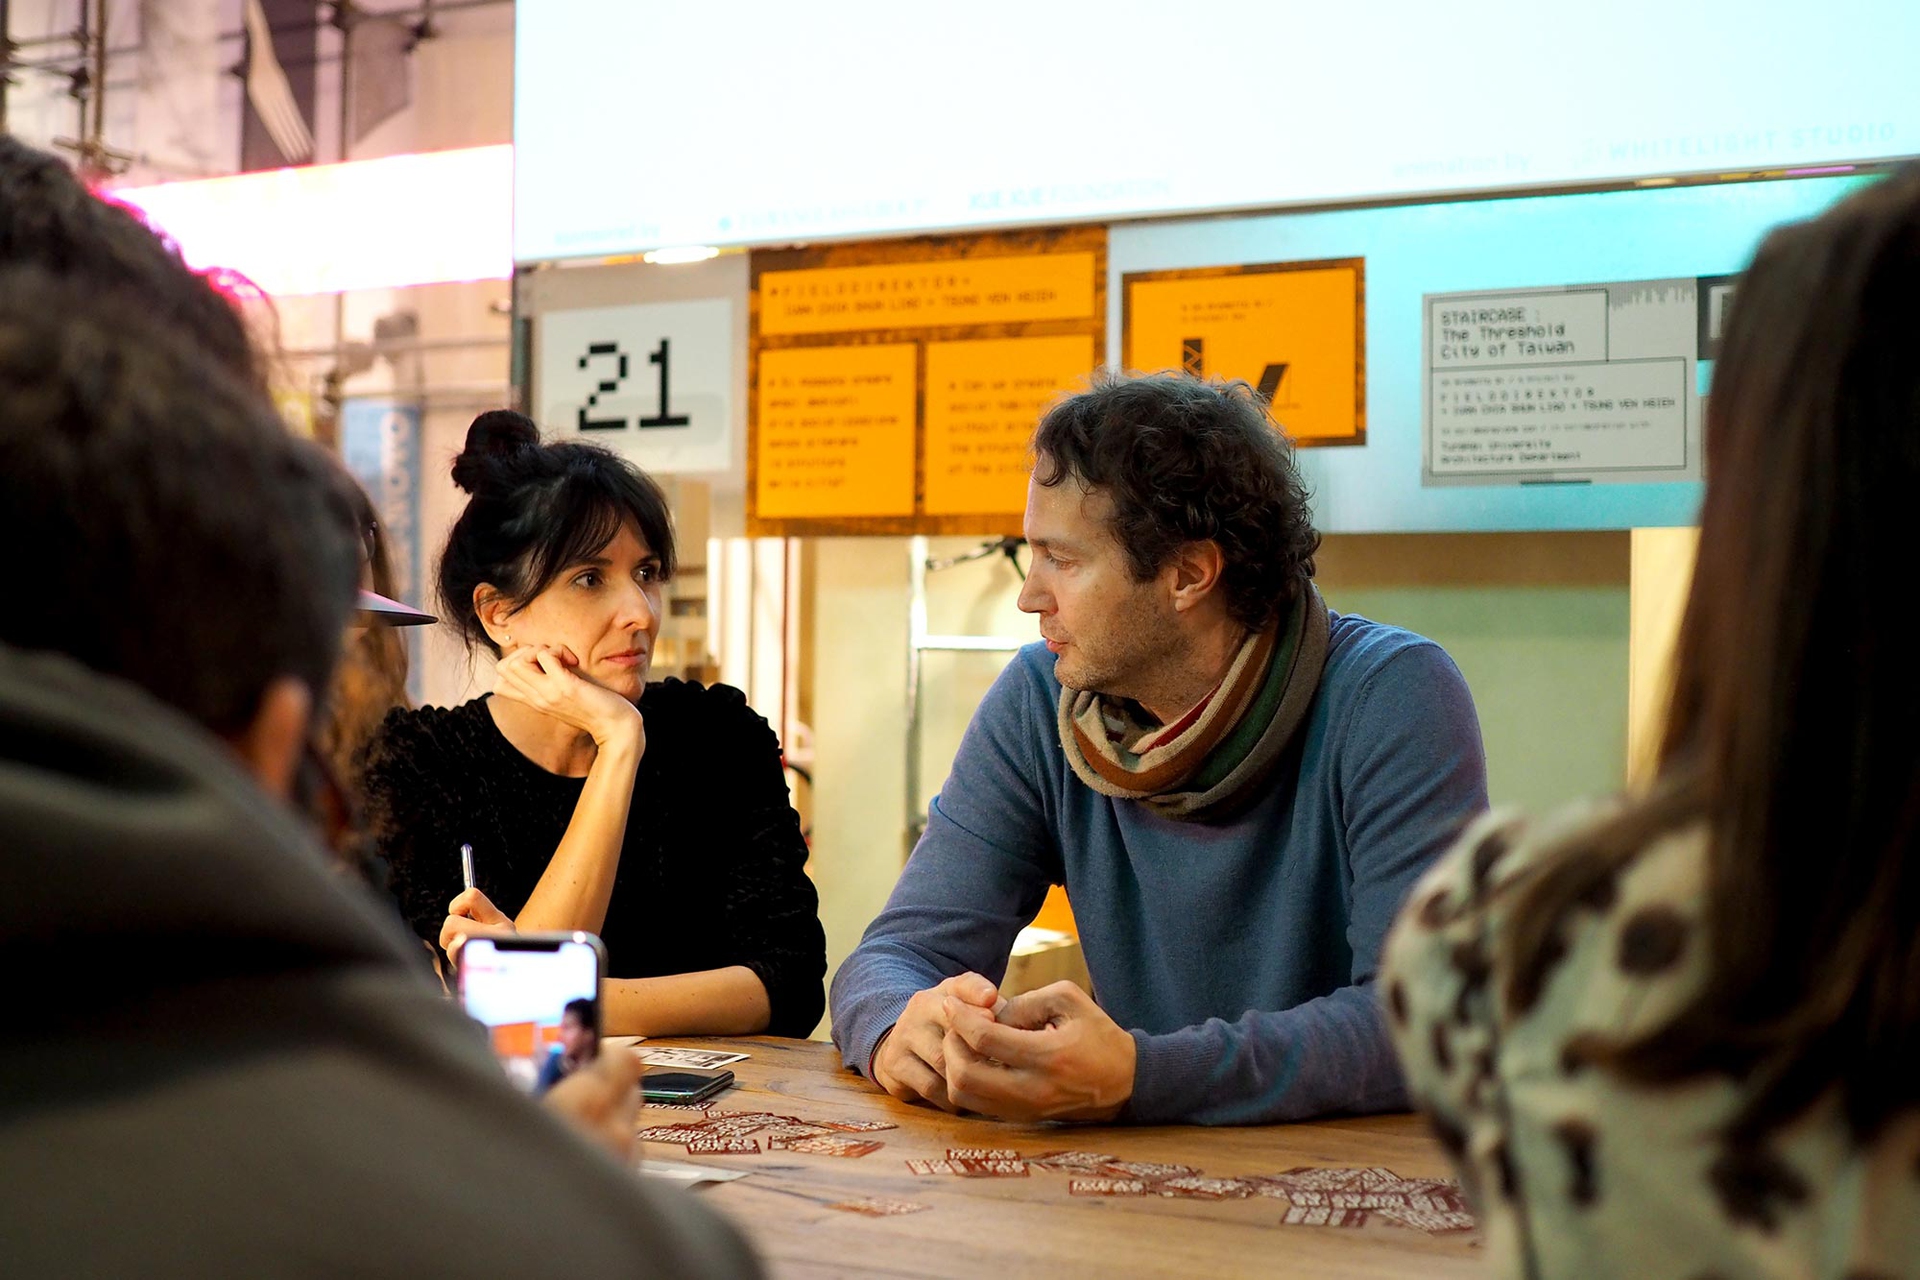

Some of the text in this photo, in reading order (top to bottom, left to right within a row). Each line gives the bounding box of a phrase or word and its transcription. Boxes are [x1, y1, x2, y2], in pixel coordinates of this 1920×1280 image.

[1790, 122, 1896, 149] STUDIO
[1441, 307, 1526, 326] STAIRCASE
[1443, 322, 1566, 342] The Threshold
[1441, 340, 1576, 360] City of Taiwan
[578, 339, 690, 430] 21
